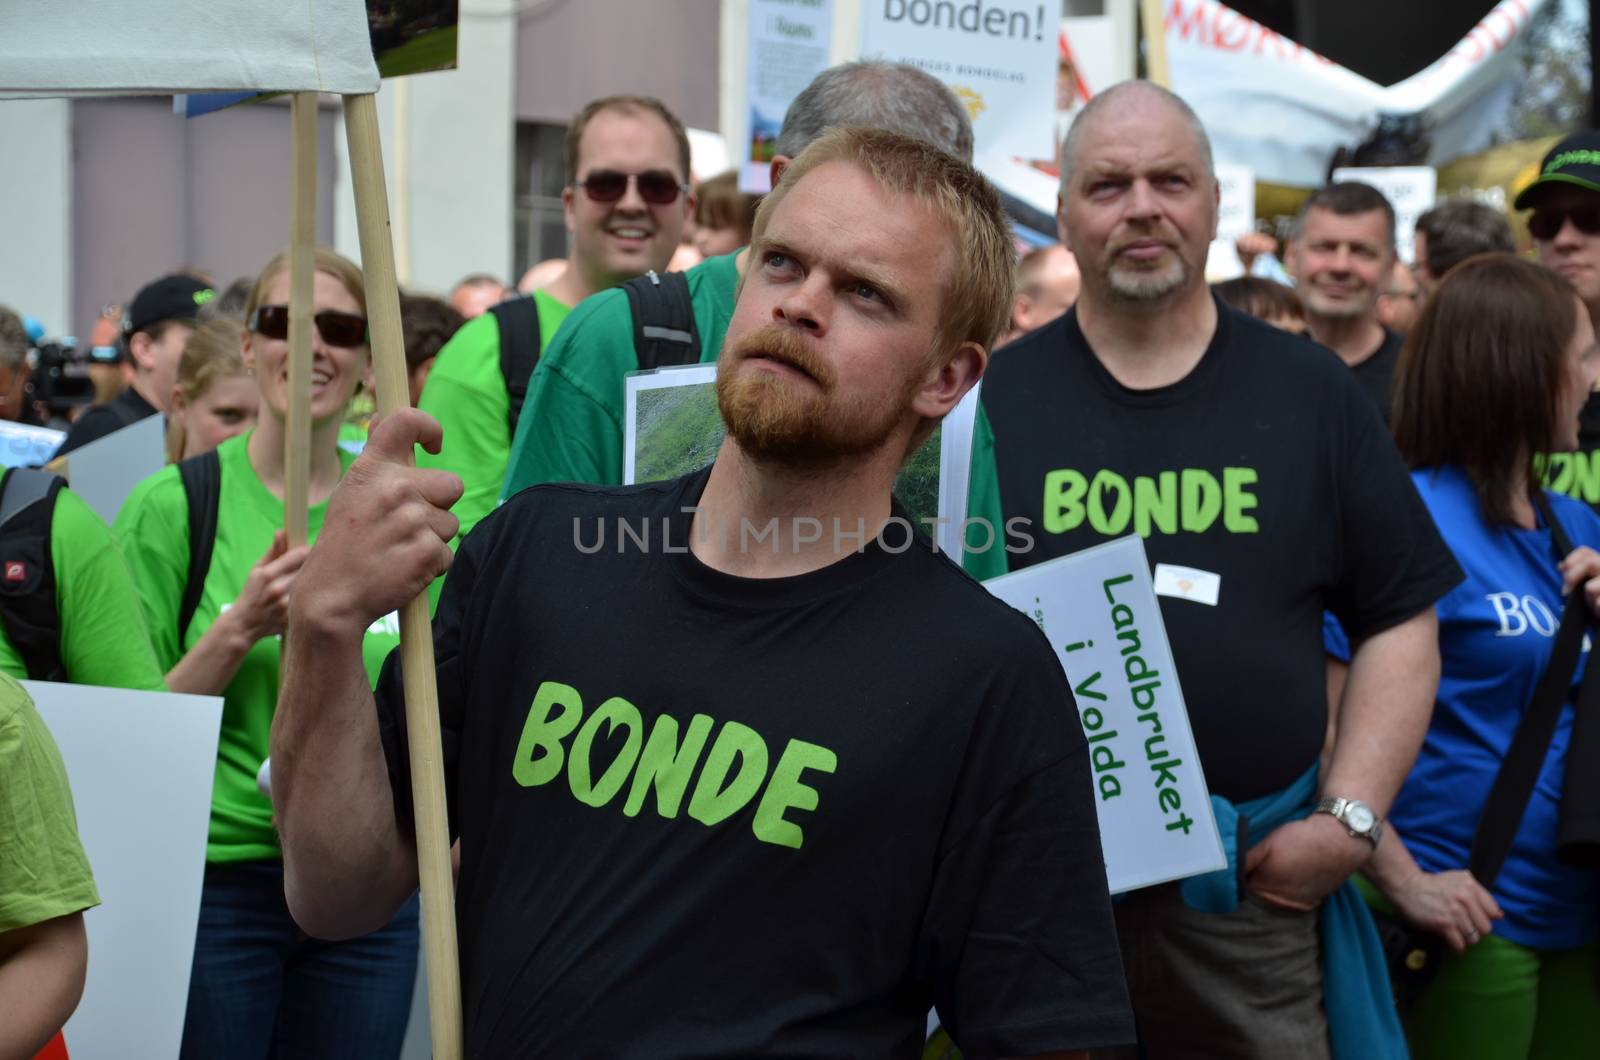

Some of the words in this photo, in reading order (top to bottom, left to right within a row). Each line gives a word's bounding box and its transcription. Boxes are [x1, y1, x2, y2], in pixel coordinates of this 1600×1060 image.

[884, 0, 1044, 41] bonden!
[1043, 467, 1259, 538] BONDE
[1065, 640, 1094, 652] i
[1075, 671, 1126, 801] Volda
[1103, 574, 1193, 834] Landbruket
[512, 681, 838, 849] BONDE
